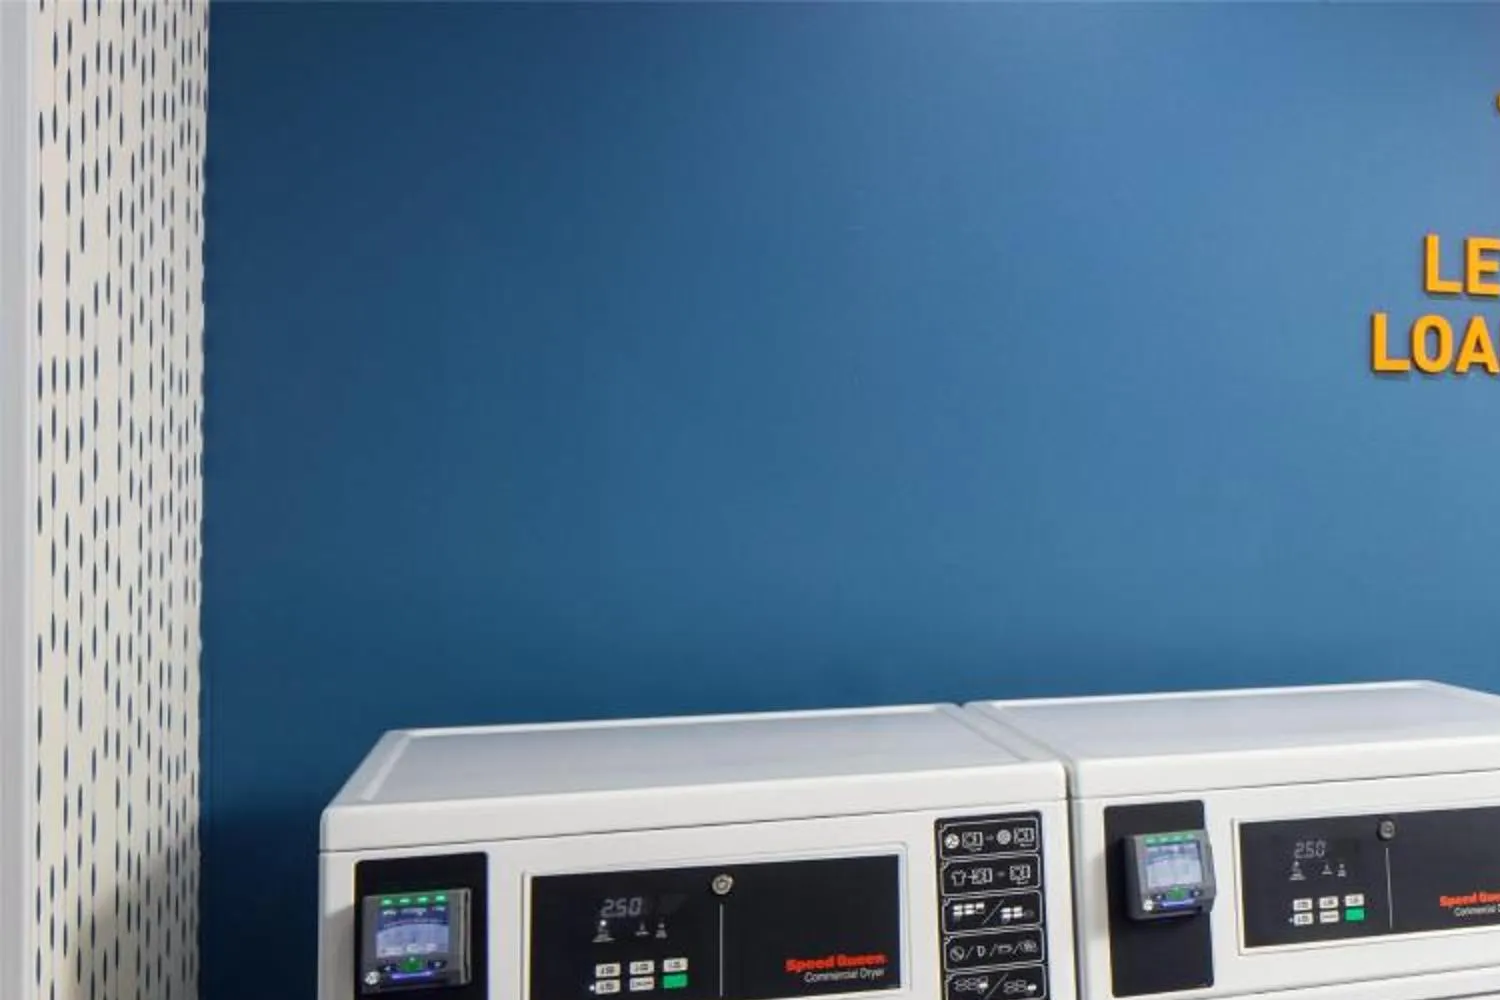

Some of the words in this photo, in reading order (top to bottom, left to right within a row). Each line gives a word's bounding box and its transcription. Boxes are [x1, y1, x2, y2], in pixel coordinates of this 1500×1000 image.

[1294, 839, 1327, 859] 250
[600, 897, 642, 918] 250
[785, 956, 835, 974] Speed
